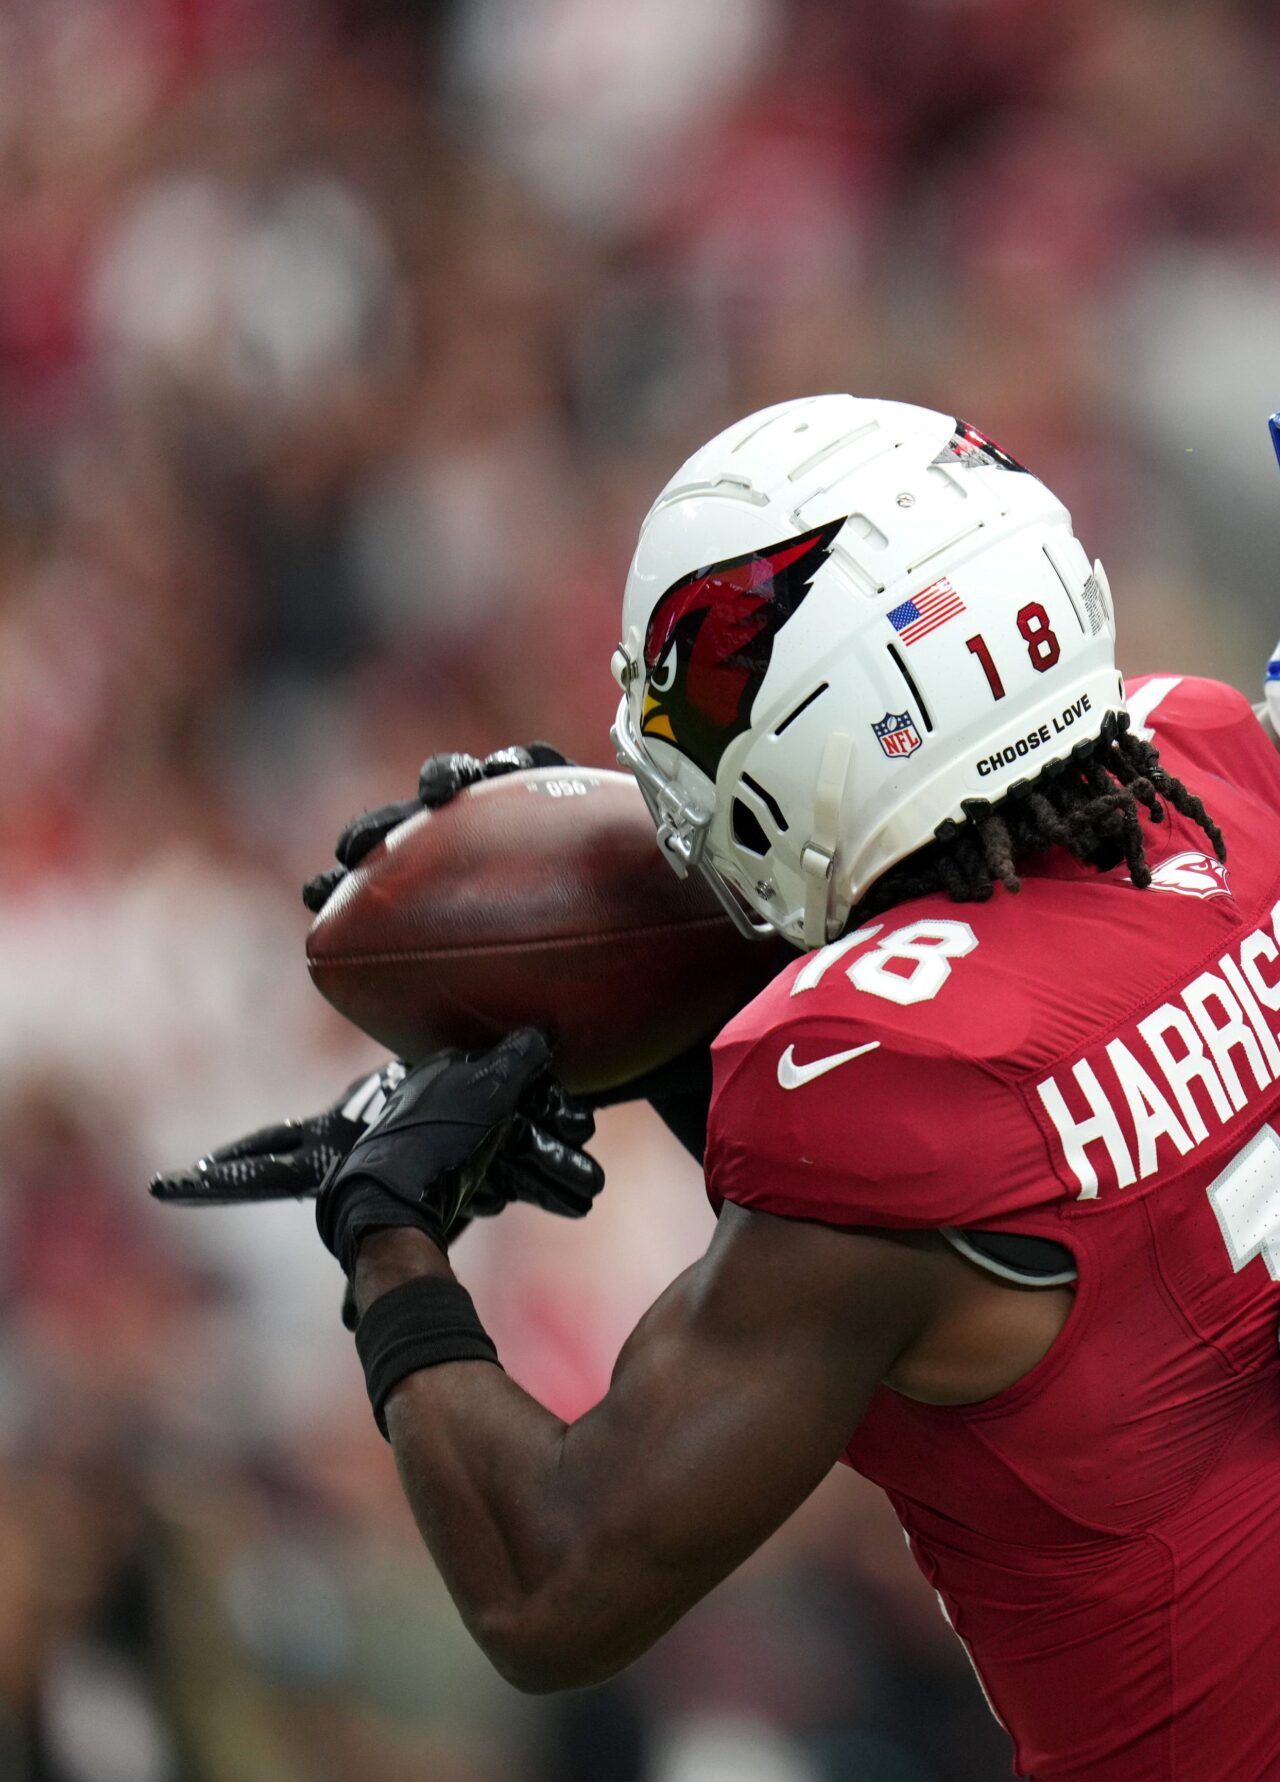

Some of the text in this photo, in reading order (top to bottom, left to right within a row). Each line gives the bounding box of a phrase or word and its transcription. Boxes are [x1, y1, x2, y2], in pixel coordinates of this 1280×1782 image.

[966, 601, 1062, 702] 18
[882, 728, 919, 755] NFL
[976, 724, 1052, 777] CHOOSE
[1052, 693, 1092, 734] LOVE
[789, 918, 980, 1007] 18
